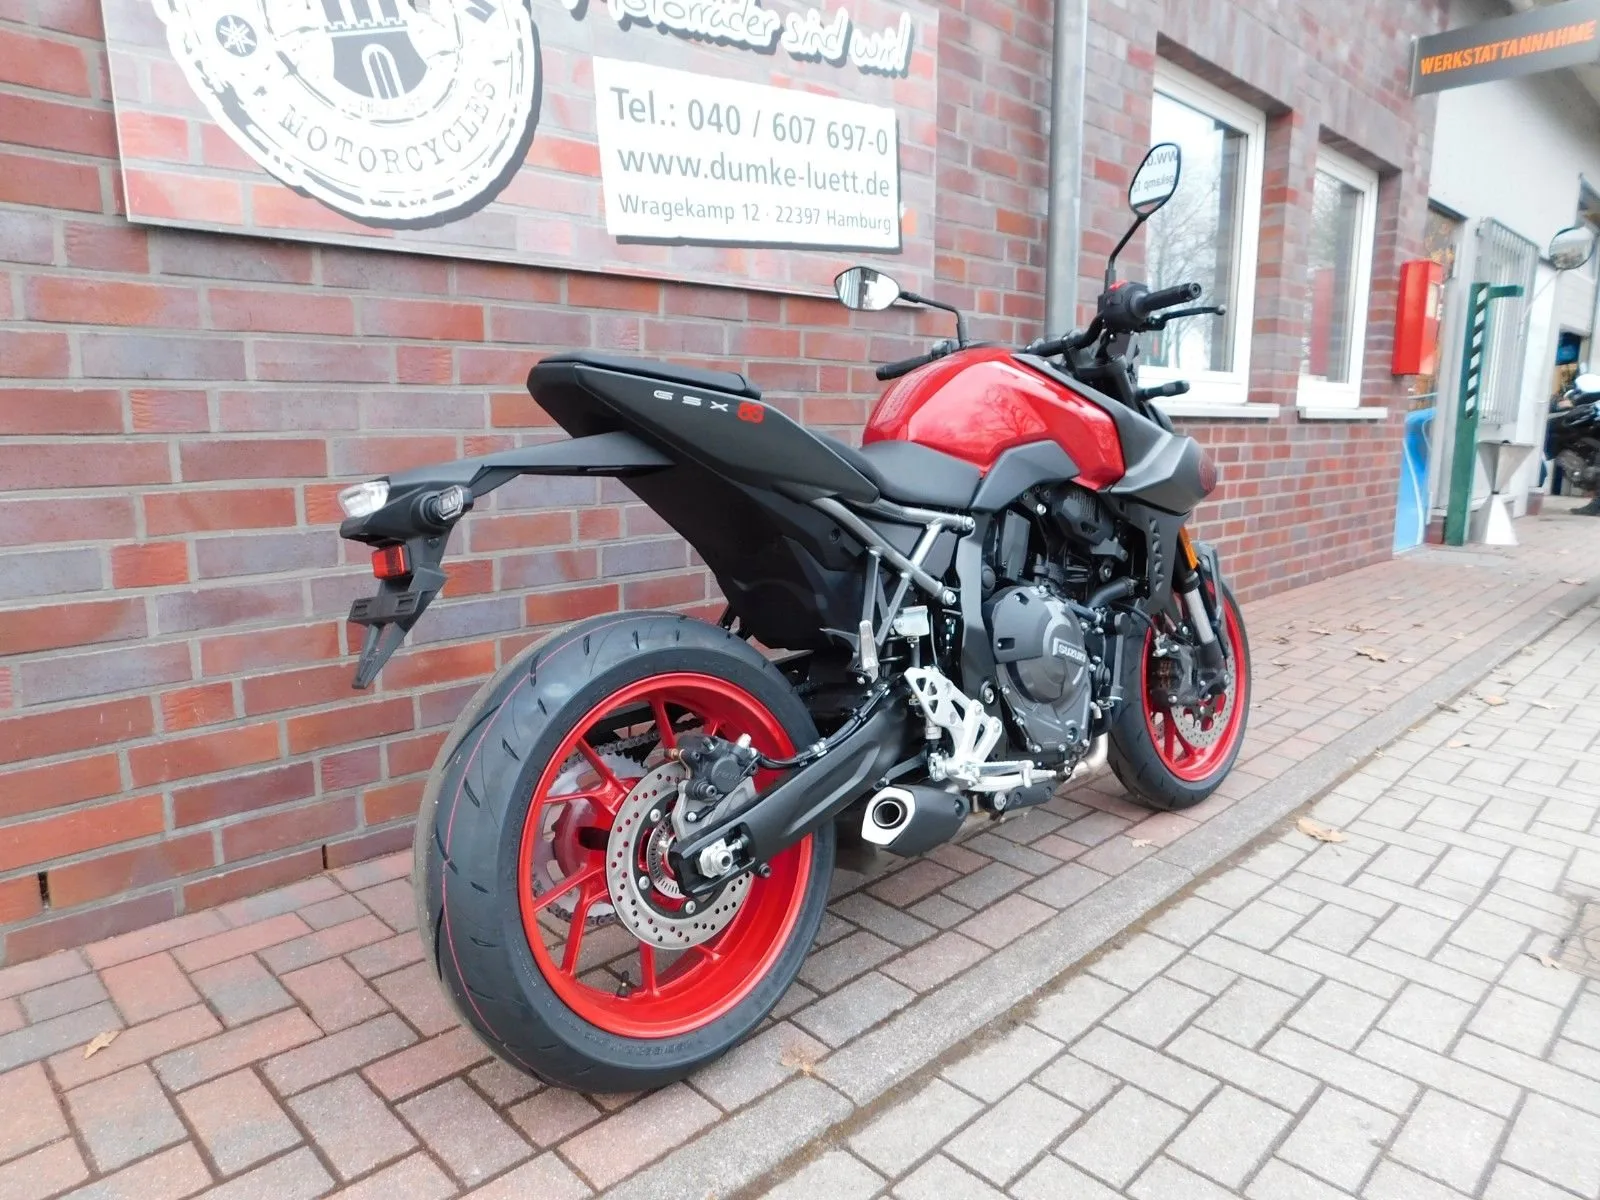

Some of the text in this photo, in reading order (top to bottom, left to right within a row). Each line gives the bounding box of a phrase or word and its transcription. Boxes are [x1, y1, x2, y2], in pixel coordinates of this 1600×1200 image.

[785, 11, 846, 55] sind
[1420, 20, 1597, 76] WERKSTATTANNAHME
[278, 77, 496, 174] MOTORCYCLES
[609, 86, 676, 128] Tel.:
[687, 98, 741, 136] 040
[772, 112, 816, 145] 607
[826, 121, 888, 156] 697-0
[616, 148, 889, 197] www.dumke-luett.de
[618, 193, 735, 225] Wragekamp
[742, 203, 761, 222] 12
[775, 204, 820, 225] 22397
[826, 208, 891, 236] Hamburg
[1058, 644, 1086, 663] SUZUKI
